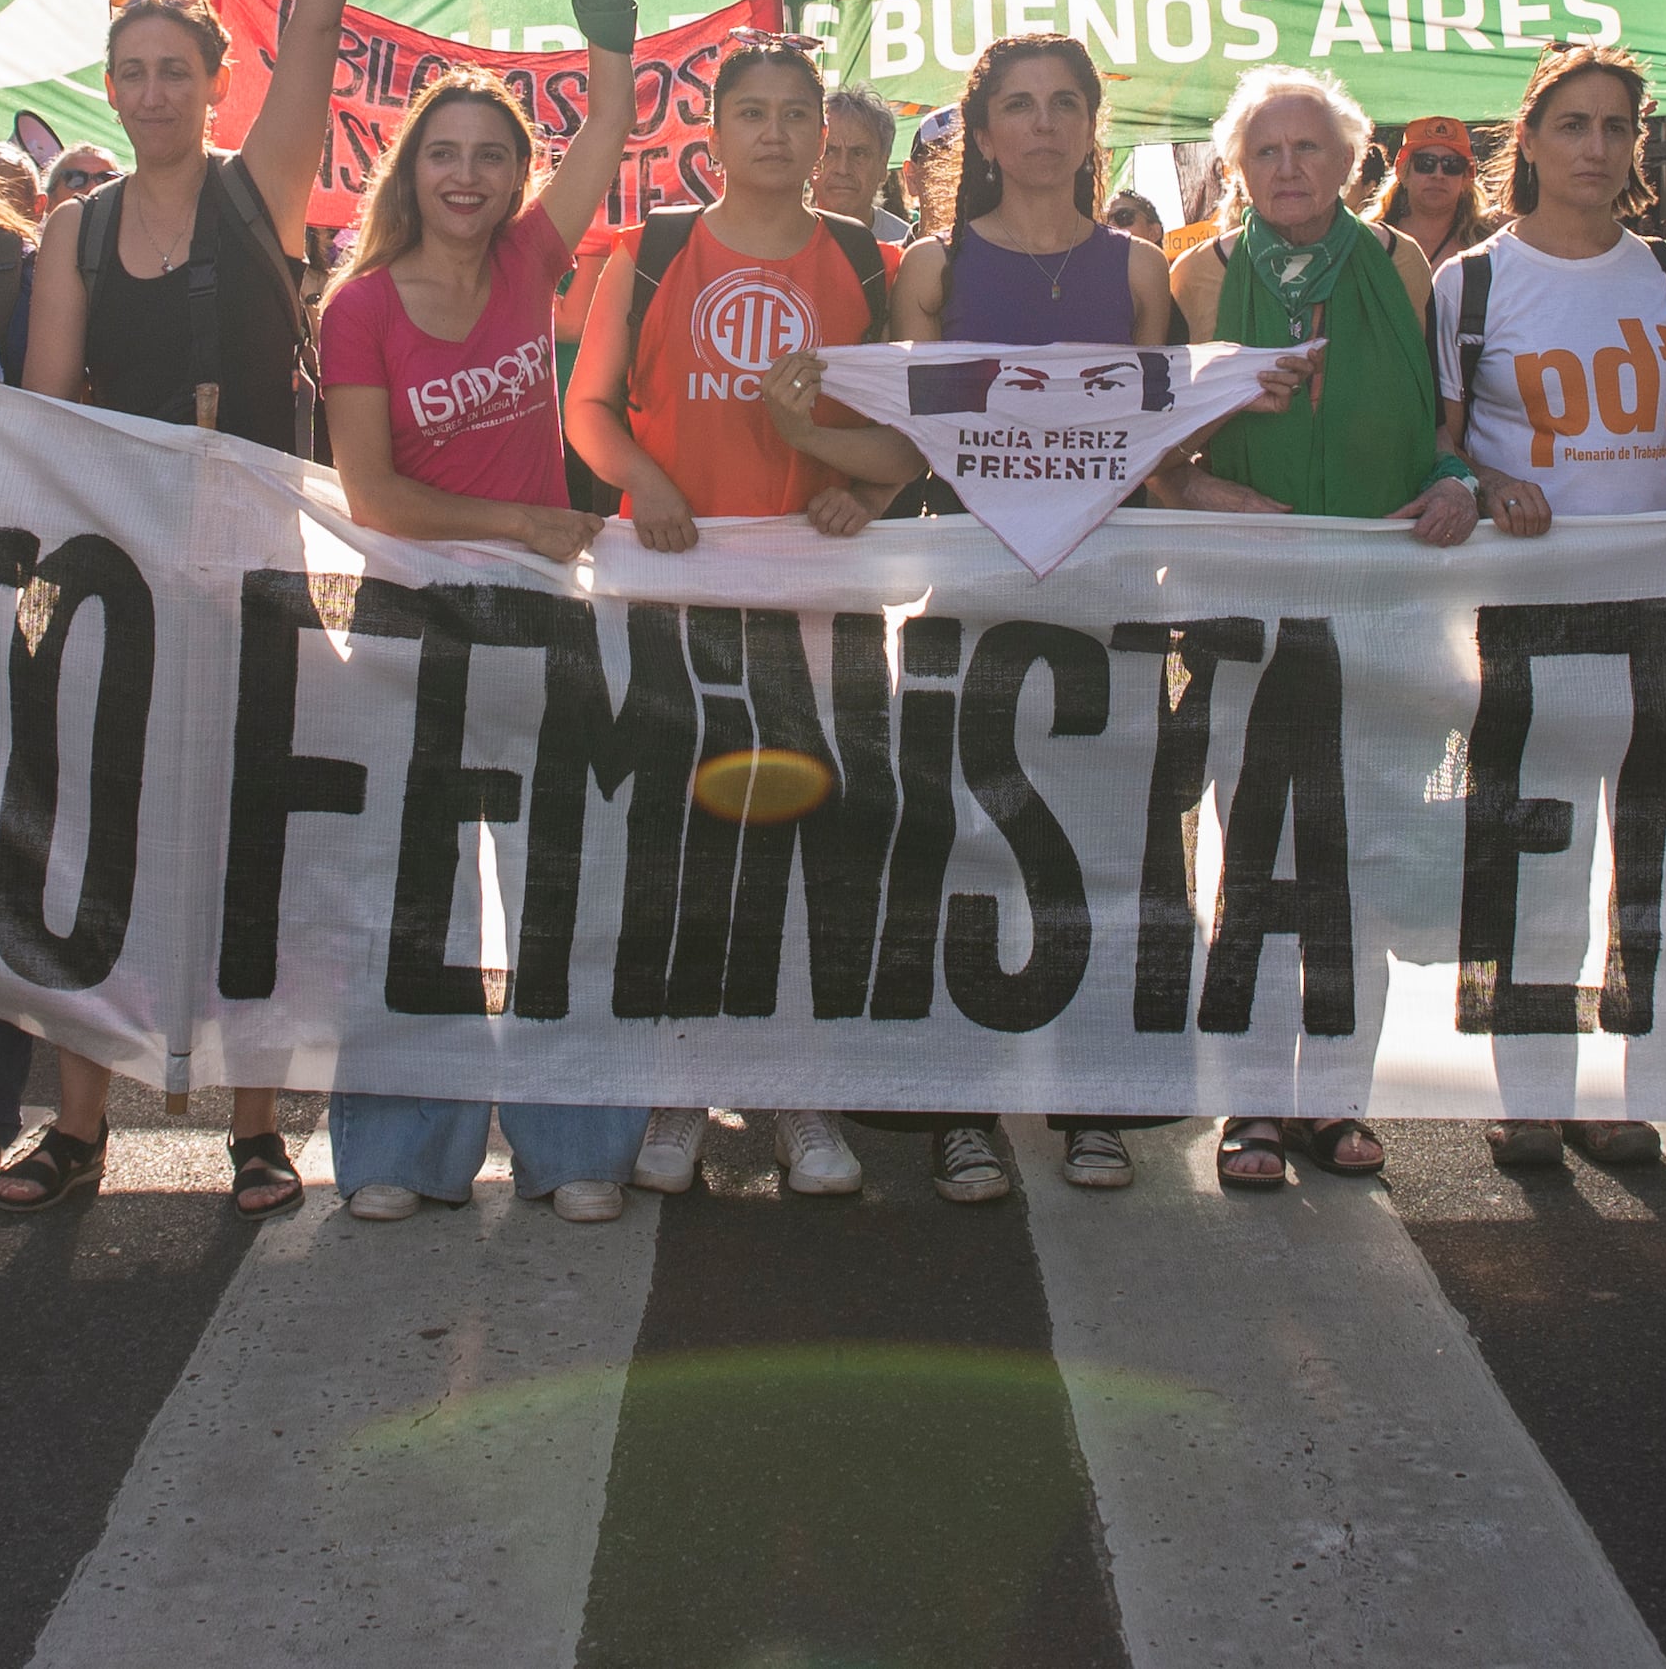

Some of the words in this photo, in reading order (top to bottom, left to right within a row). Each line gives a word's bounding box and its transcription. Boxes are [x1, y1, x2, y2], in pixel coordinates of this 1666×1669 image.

[688, 372, 766, 401] INC
[466, 411, 479, 423] EN
[482, 399, 511, 417] LUCHA
[958, 426, 1033, 450] LUCÍA
[1044, 426, 1129, 450] PÉREZ
[1564, 446, 1615, 462] Plenario
[1618, 447, 1630, 460] de
[956, 453, 1128, 481] PRESENTE
